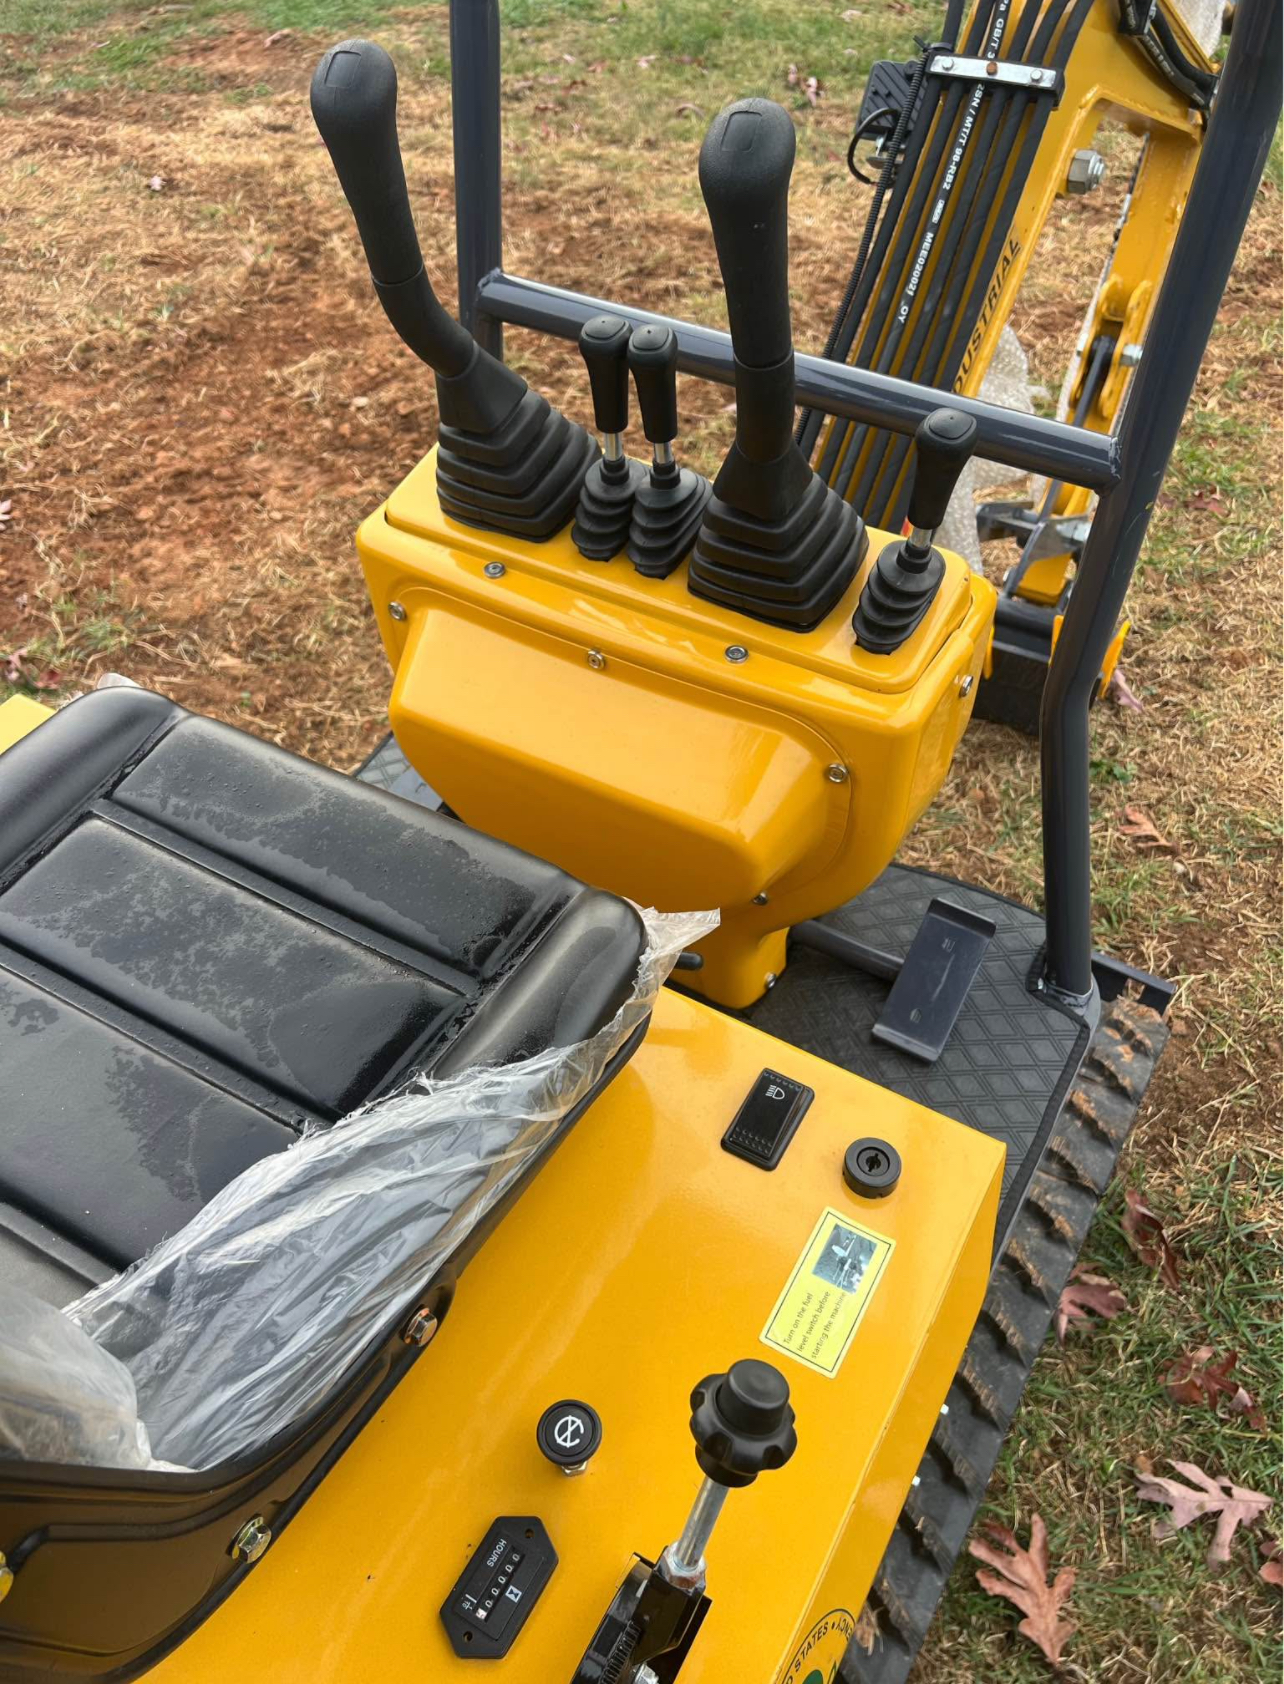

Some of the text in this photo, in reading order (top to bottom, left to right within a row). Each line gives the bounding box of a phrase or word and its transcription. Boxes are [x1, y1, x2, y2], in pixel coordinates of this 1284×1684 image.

[990, 18, 1005, 50] GB/T
[972, 83, 985, 107] 2SN
[959, 116, 974, 146] MT/T
[942, 147, 963, 190] 98-RB2
[783, 1293, 813, 1344] Turn on the fuel
[797, 1291, 831, 1352] level switch before
[811, 1292, 847, 1359] starting the machine
[486, 1539, 507, 1567] HOURS
[794, 1621, 829, 1672] STATES
